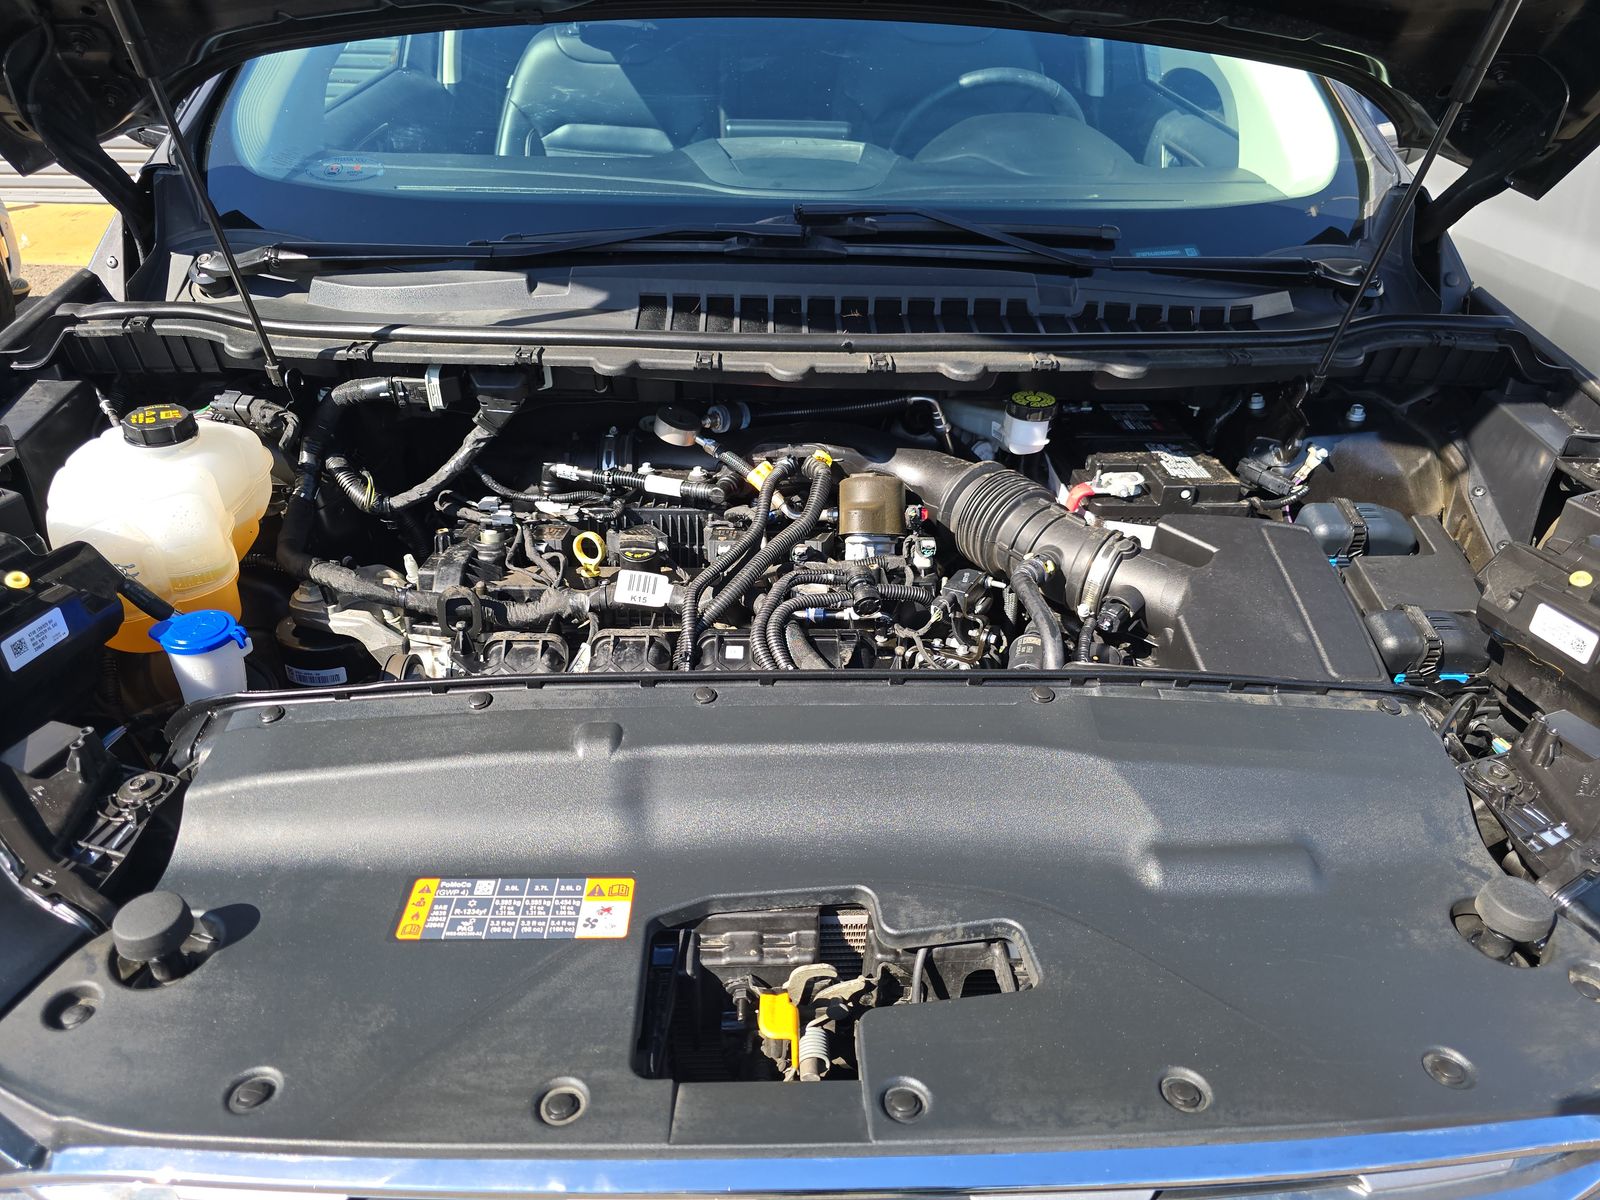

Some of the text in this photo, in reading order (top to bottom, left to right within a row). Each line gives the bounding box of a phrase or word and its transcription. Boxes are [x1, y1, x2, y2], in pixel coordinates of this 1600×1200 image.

[630, 595, 647, 603] K15
[513, 899, 522, 907] kg
[544, 899, 552, 907] kg
[573, 899, 581, 907] kg
